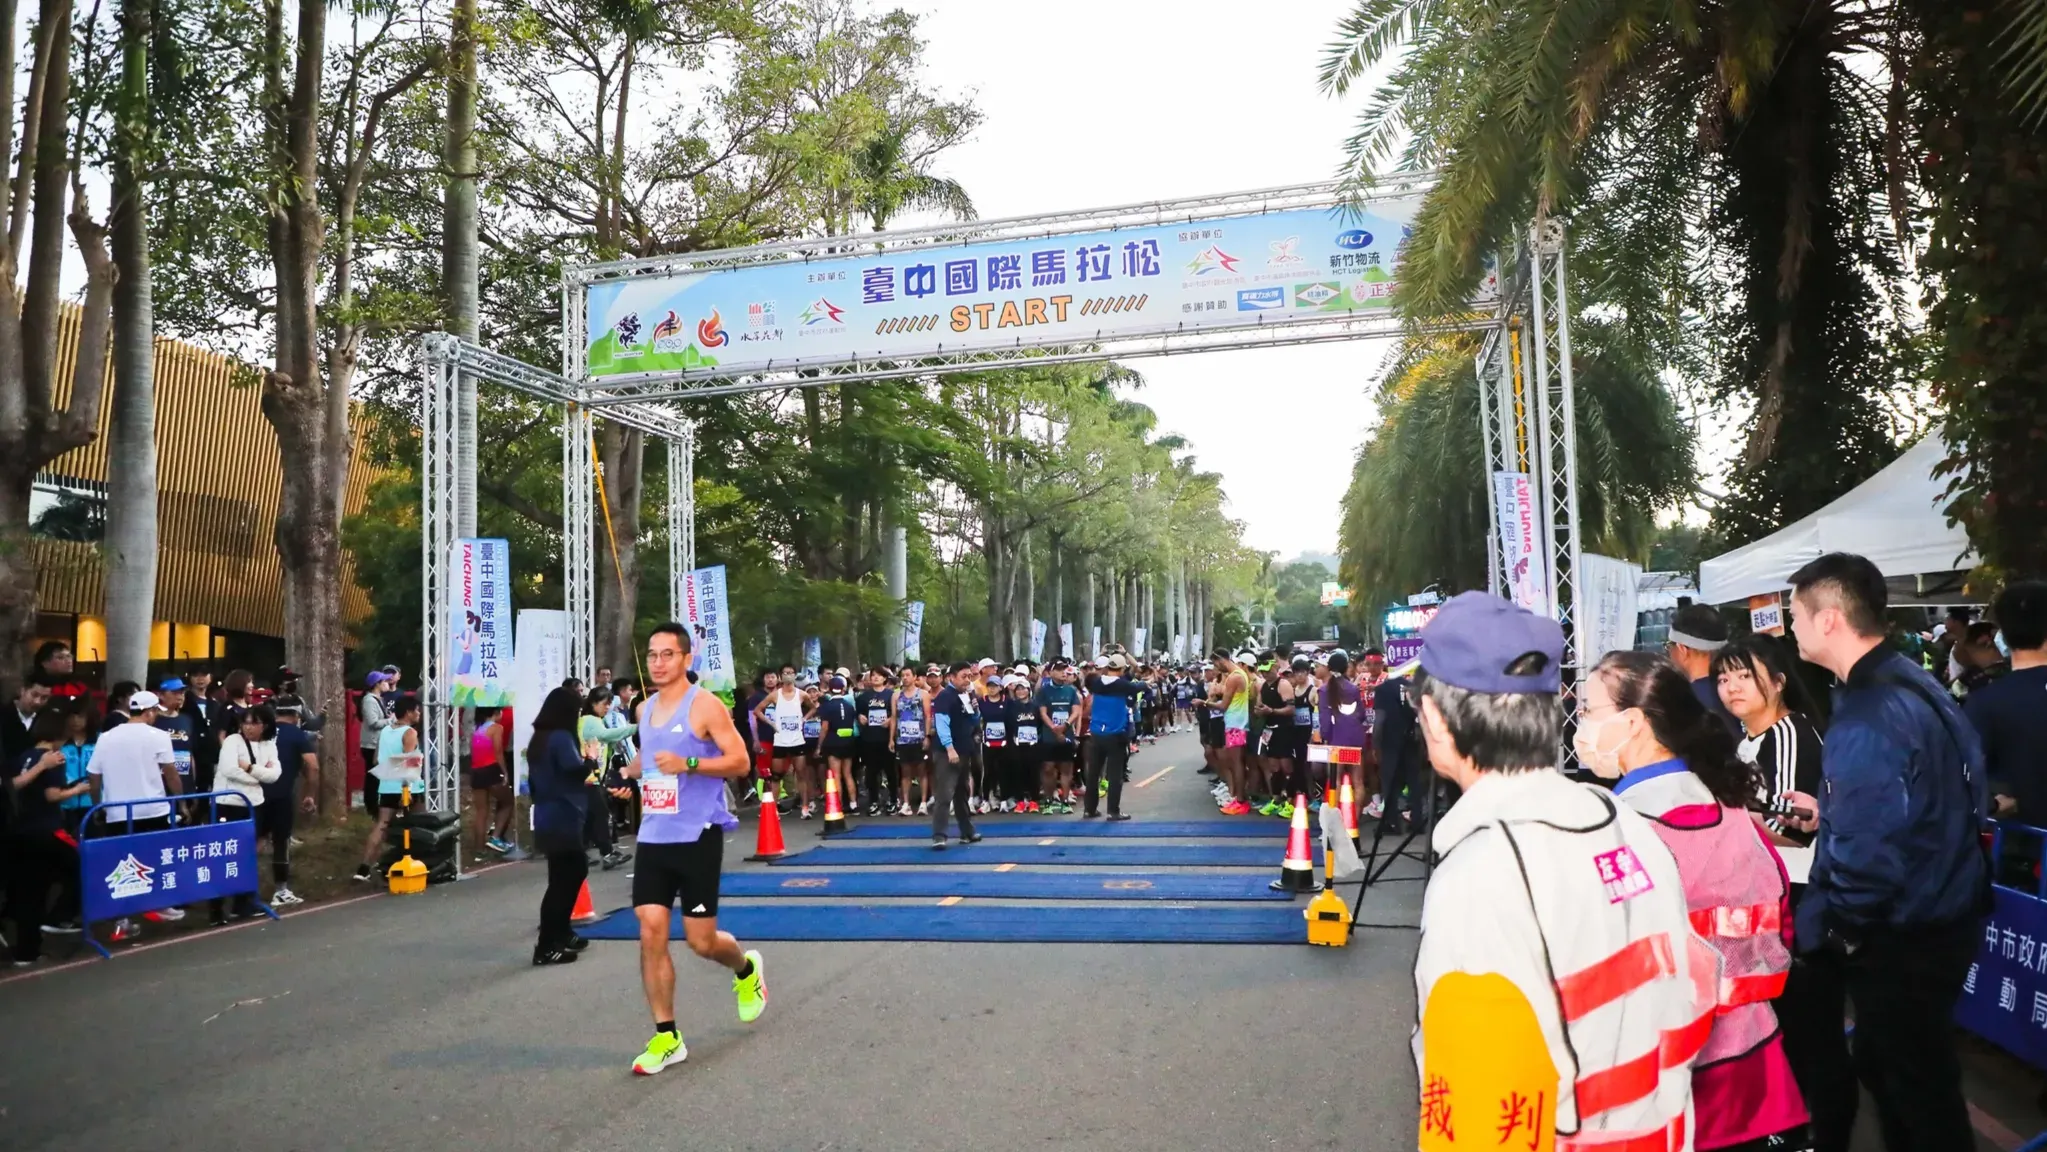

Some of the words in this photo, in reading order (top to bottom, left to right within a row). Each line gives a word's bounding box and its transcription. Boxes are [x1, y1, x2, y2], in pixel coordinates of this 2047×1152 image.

[1329, 252, 1381, 268] 新竹物流
[1339, 233, 1370, 246] HCT
[862, 239, 1161, 304] 臺中國際馬拉松
[1332, 268, 1347, 276] HCT
[949, 295, 1073, 332] START
[463, 543, 472, 607] TAICHUNG
[480, 542, 498, 679] 臺中國際馬拉松
[686, 574, 698, 622] TAICHUNG
[700, 570, 722, 672] 臺中國際馬拉松
[160, 839, 239, 865] 臺中市政府
[161, 861, 239, 890] 運動局
[1420, 1073, 1546, 1151] 裁判
